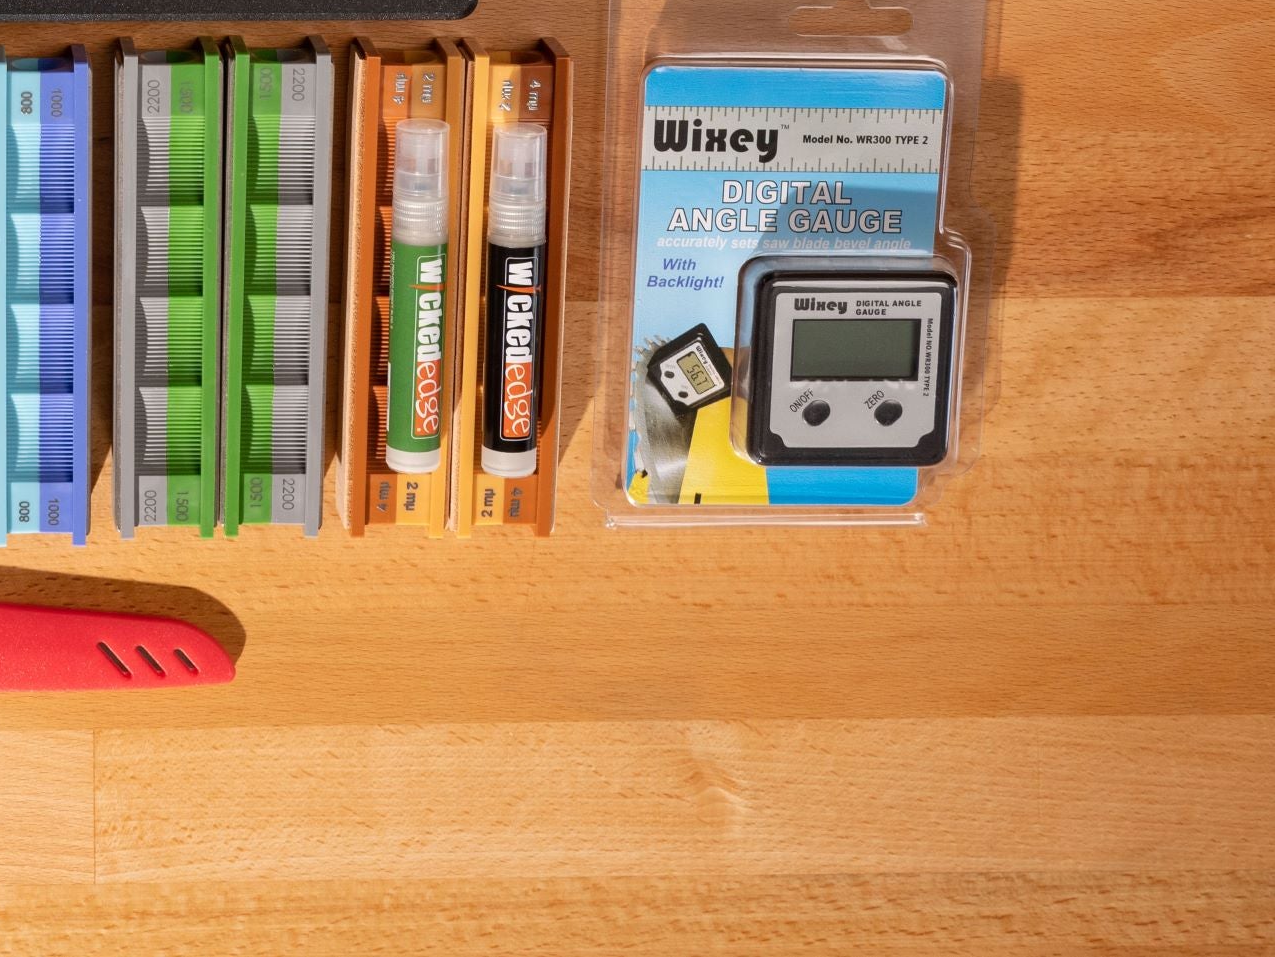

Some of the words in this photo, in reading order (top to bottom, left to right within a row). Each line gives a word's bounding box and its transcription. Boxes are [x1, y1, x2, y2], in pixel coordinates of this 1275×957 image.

[147, 79, 160, 113] 2200
[293, 68, 305, 101] 2200
[21, 91, 32, 115] 800
[51, 88, 62, 117] 1000
[654, 119, 779, 163] Wixey
[803, 134, 833, 144] Model
[836, 134, 853, 144] No.
[856, 135, 891, 145] WR300
[895, 135, 919, 145] TYPE
[922, 136, 928, 145] 2
[722, 179, 852, 206] DIGITAL
[666, 207, 778, 232] ANGLE
[788, 209, 903, 234] GAUGE
[657, 236, 728, 251] accurately
[731, 238, 758, 250] sets
[763, 240, 790, 250] saw
[793, 236, 830, 250] blade
[833, 237, 871, 251] bevel
[875, 238, 911, 253] angle
[663, 258, 696, 271] With
[647, 275, 724, 291] Backlight!
[794, 297, 848, 315] Wixey
[789, 388, 814, 413] ON/OFF
[864, 390, 885, 410] ZERO
[250, 477, 263, 508] 1500
[282, 478, 295, 510] 2200
[406, 481, 418, 490] 2
[19, 501, 30, 522] 800
[48, 498, 59, 526] 1000
[144, 490, 157, 522] 2200
[481, 509, 492, 518] 2
